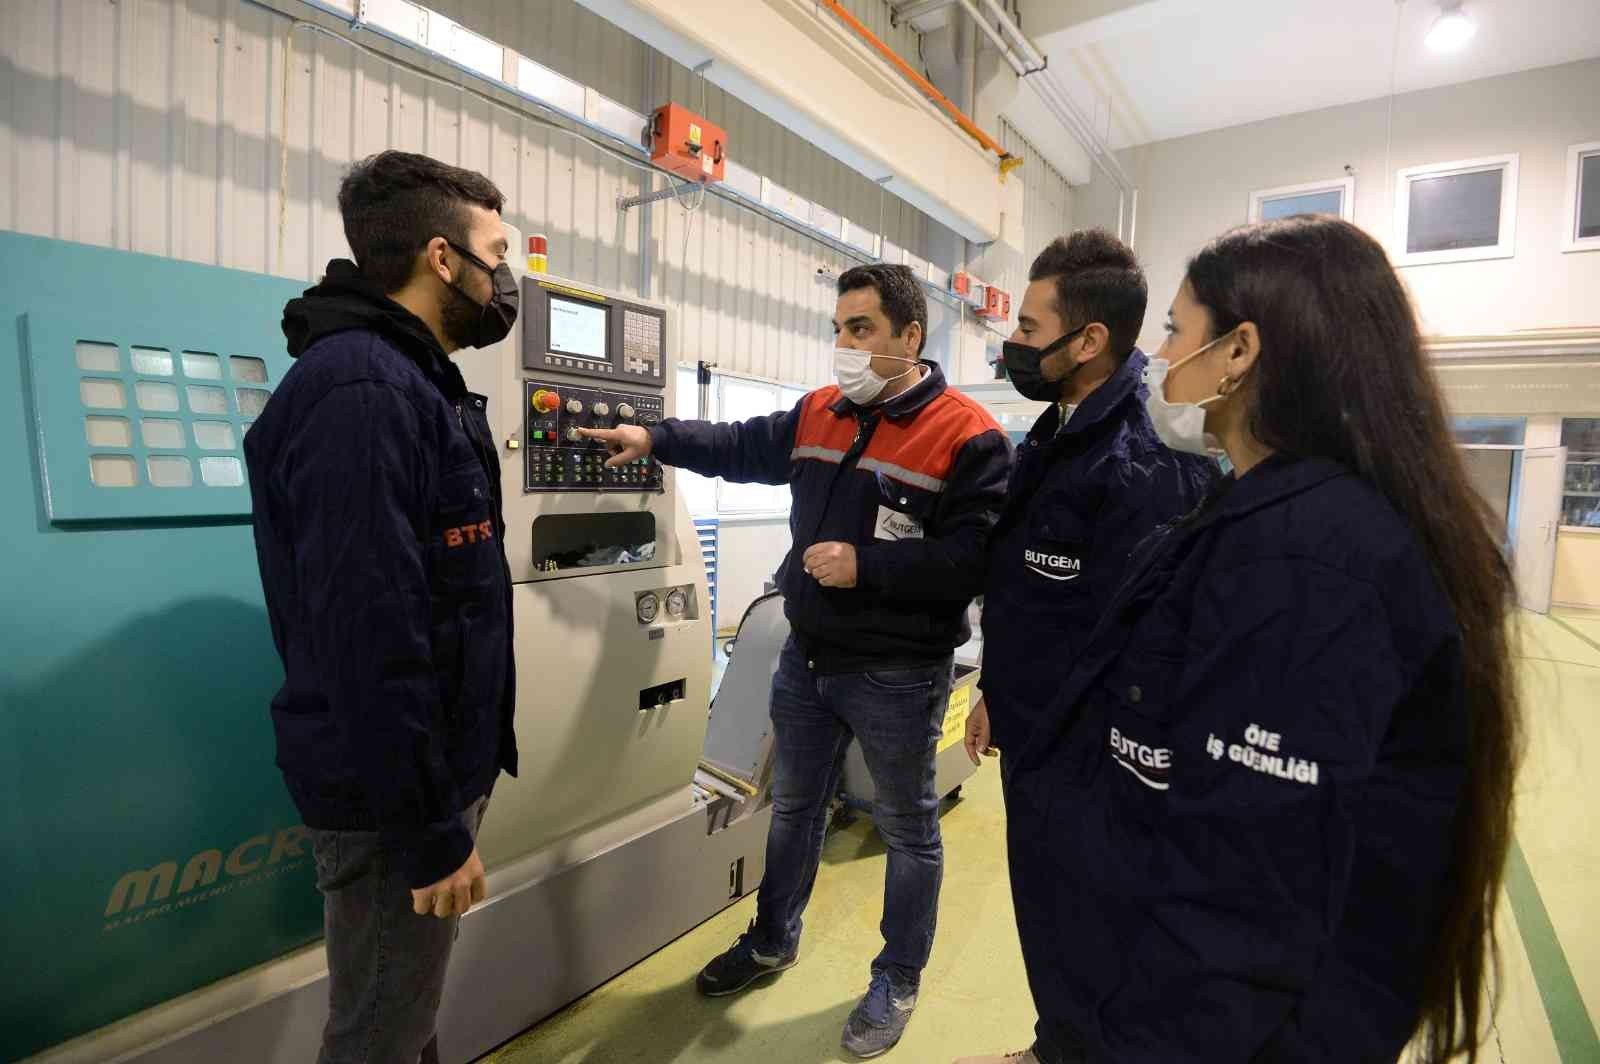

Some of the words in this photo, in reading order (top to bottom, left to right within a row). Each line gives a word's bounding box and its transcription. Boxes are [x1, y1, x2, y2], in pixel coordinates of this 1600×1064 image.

[1024, 549, 1081, 571] BUTGEM
[1110, 727, 1173, 769] BUTGE
[1206, 732, 1225, 760] İŞ
[104, 825, 312, 917] MACR
